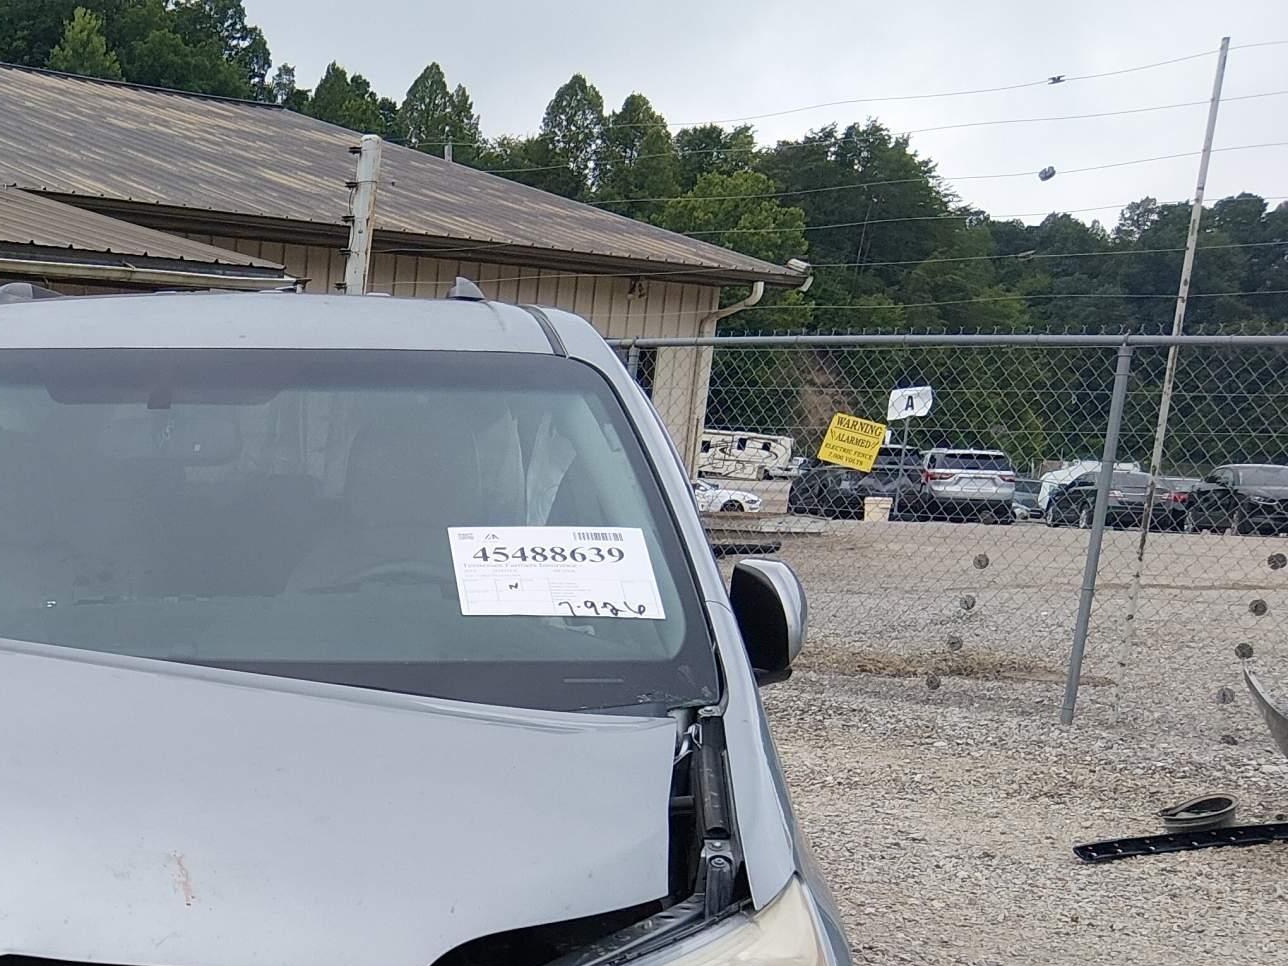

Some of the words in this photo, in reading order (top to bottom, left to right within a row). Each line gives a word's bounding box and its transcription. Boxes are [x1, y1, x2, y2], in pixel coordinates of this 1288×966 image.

[905, 395, 914, 411] A
[837, 416, 883, 437] WARNING
[835, 433, 871, 449] ALARMED
[824, 442, 853, 455] ELECTRIC
[854, 449, 873, 460] FENCE
[472, 546, 625, 563] 45488639
